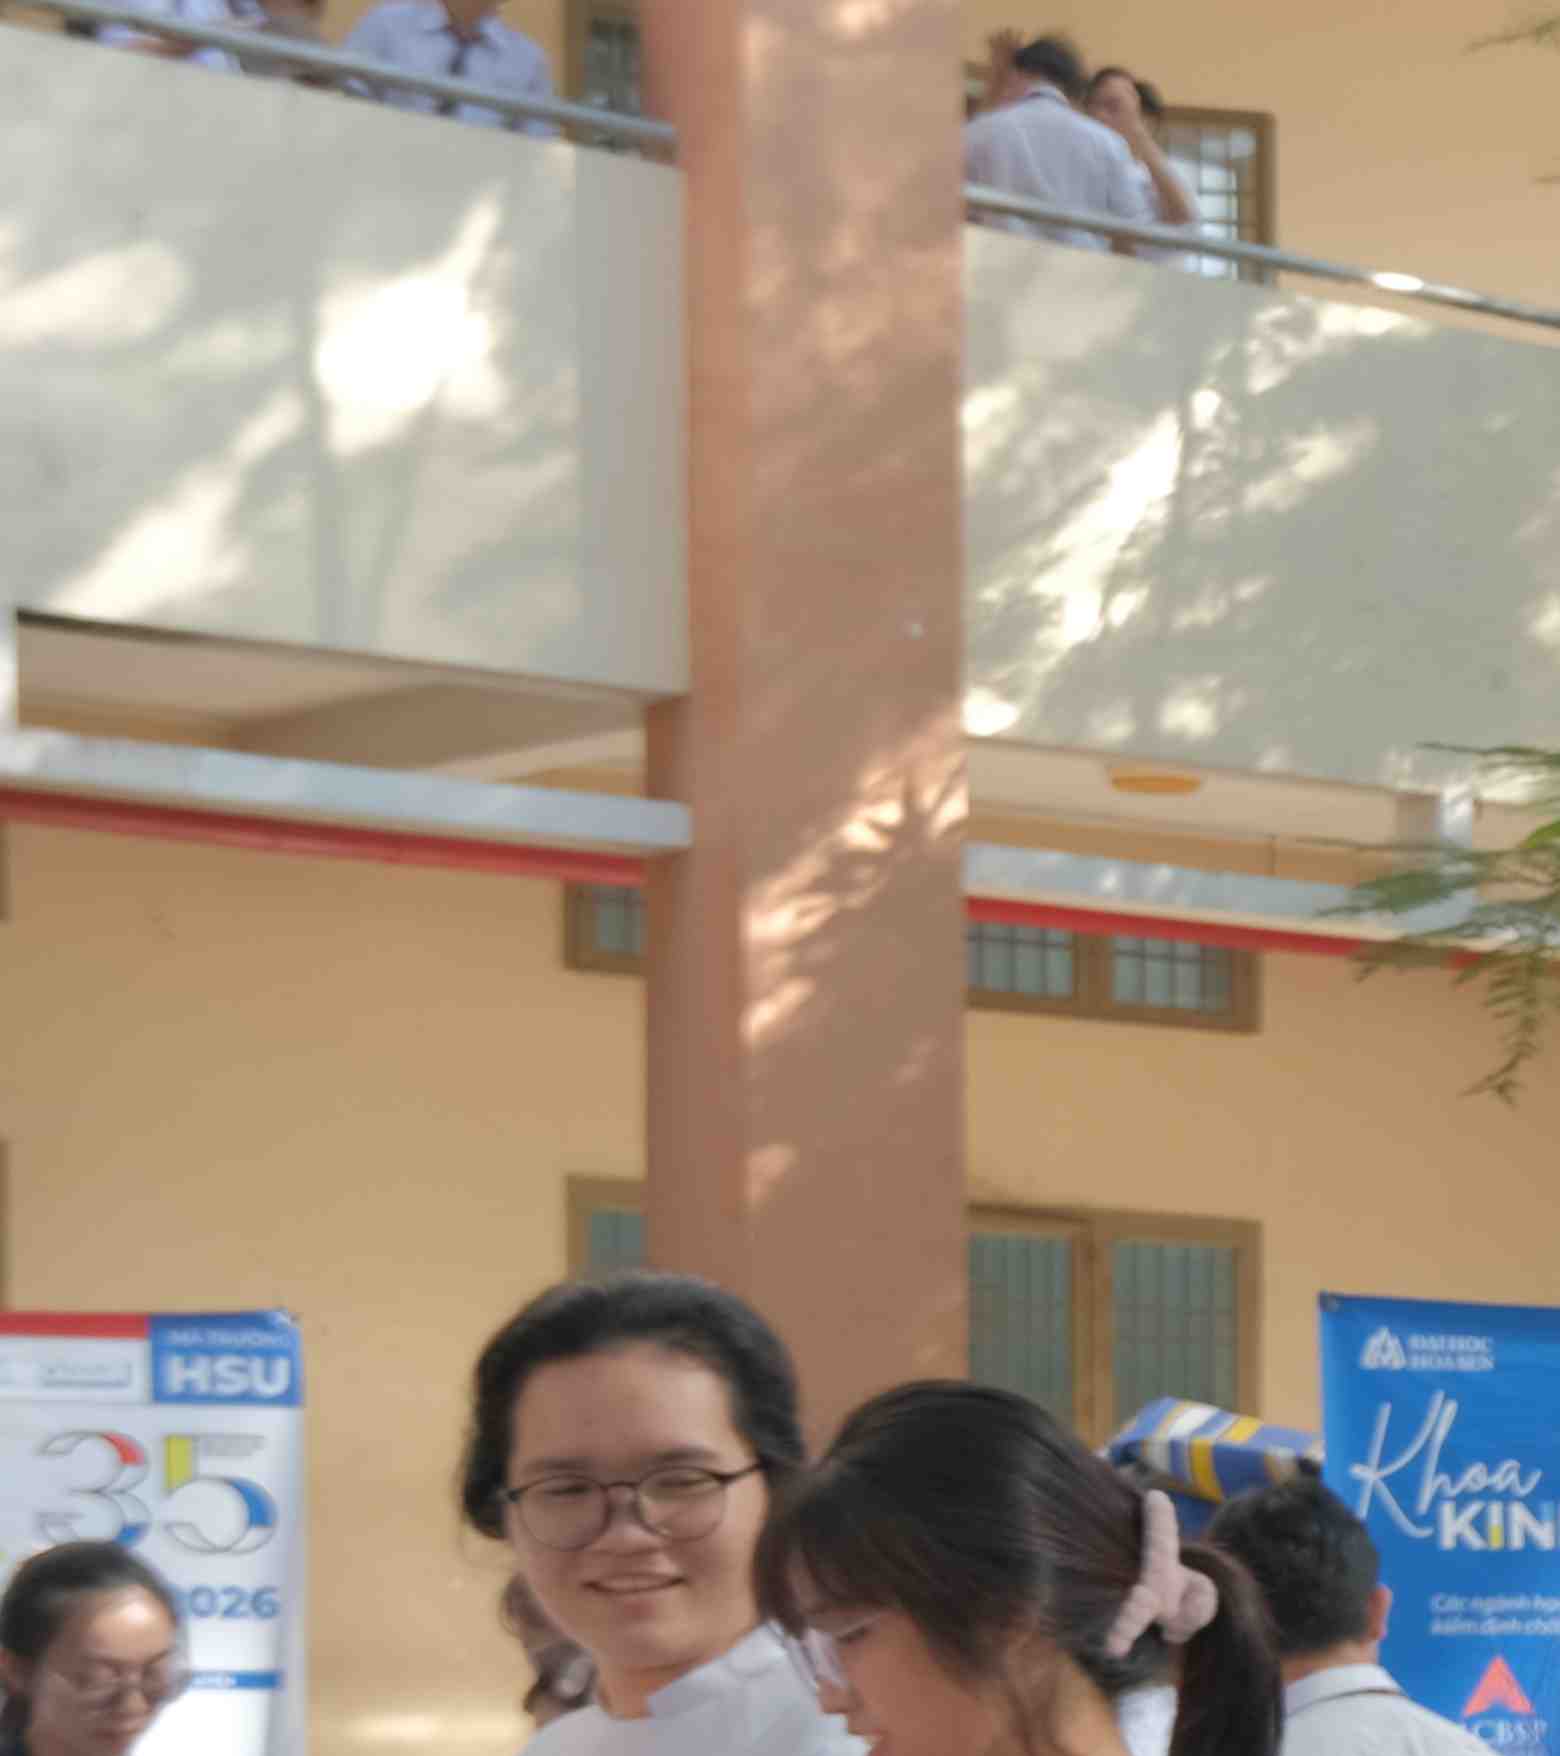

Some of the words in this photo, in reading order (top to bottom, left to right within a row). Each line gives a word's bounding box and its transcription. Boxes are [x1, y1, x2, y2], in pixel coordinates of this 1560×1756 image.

[167, 1354, 290, 1397] HSU
[1349, 1389, 1543, 1539] Khoa
[178, 1585, 281, 1621] 026
